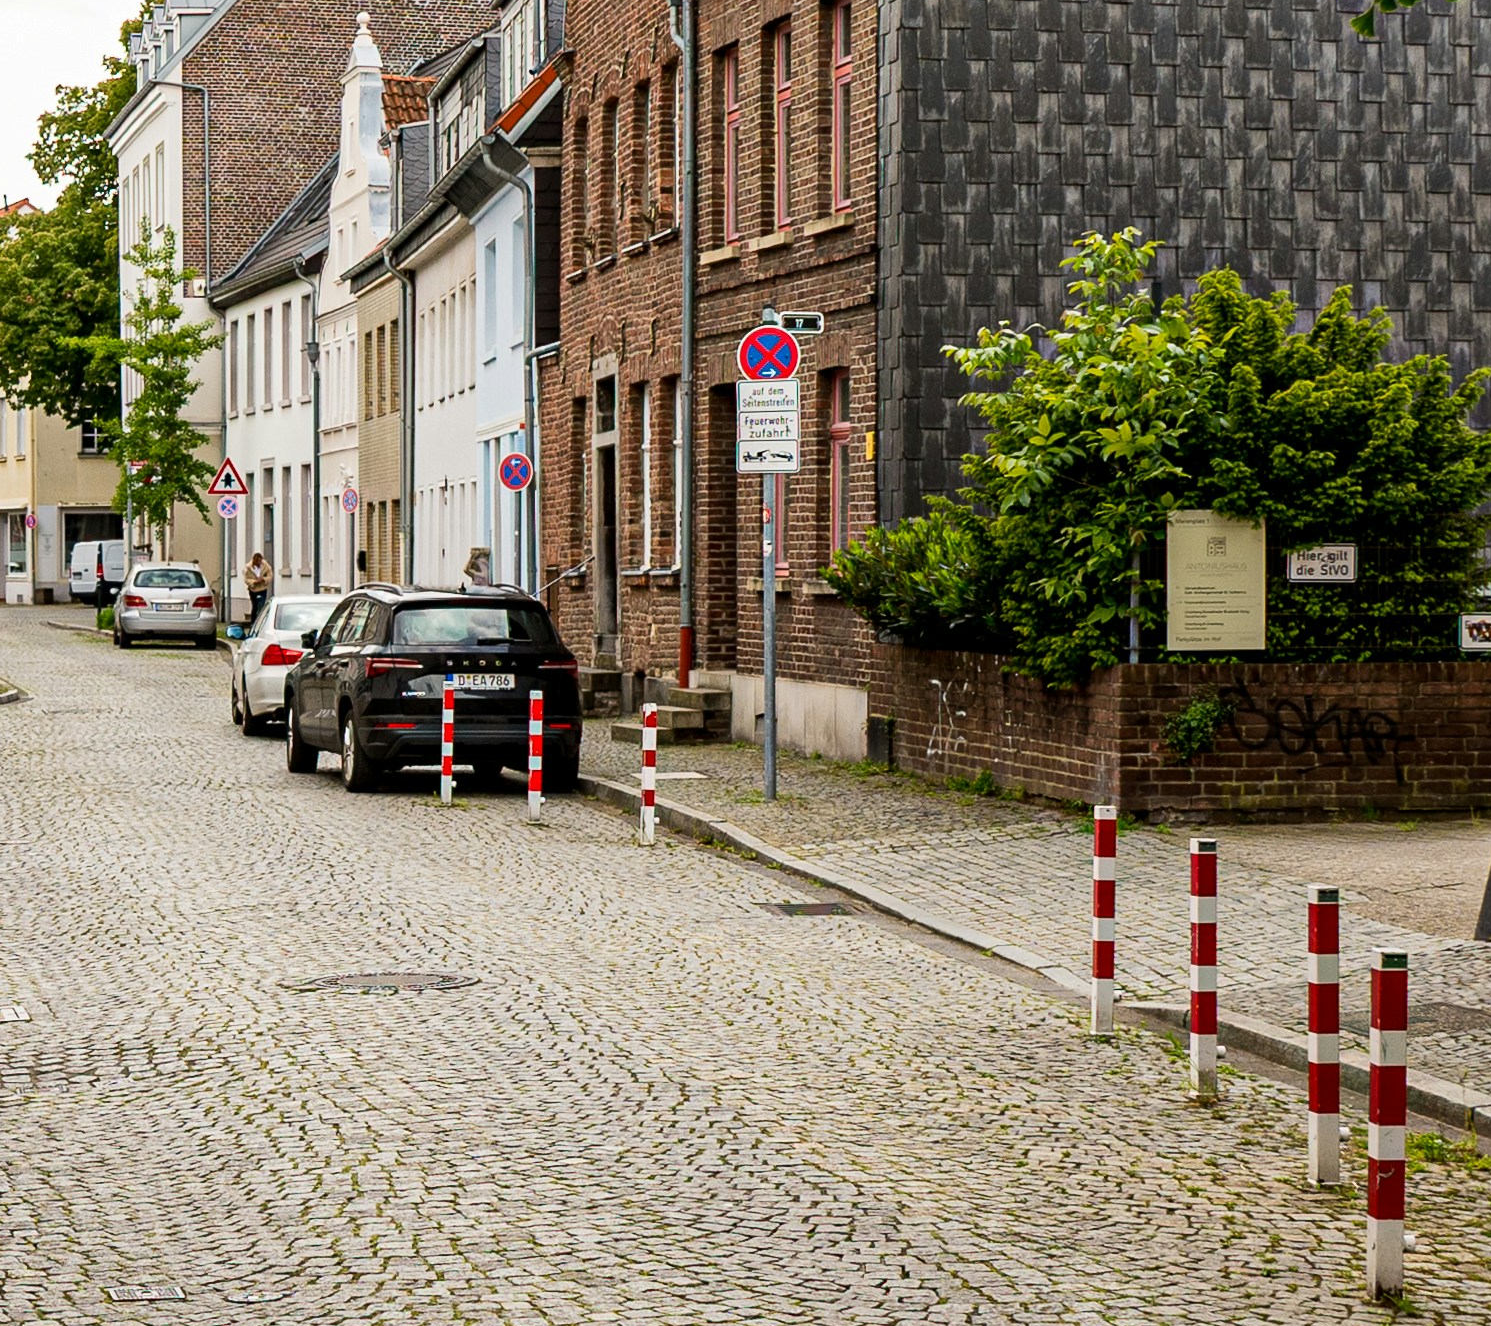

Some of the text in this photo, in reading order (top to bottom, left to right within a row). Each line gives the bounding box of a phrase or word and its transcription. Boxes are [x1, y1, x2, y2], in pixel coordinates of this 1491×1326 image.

[752, 387, 784, 396] auf dem
[742, 397, 795, 409] Seitenstreifen
[744, 415, 795, 426] Feuerwehr-
[749, 426, 791, 438] zufahrt
[1297, 550, 1348, 564] Hier gilt
[1296, 564, 1349, 576] die StVO
[458, 675, 510, 686] D EA 786
